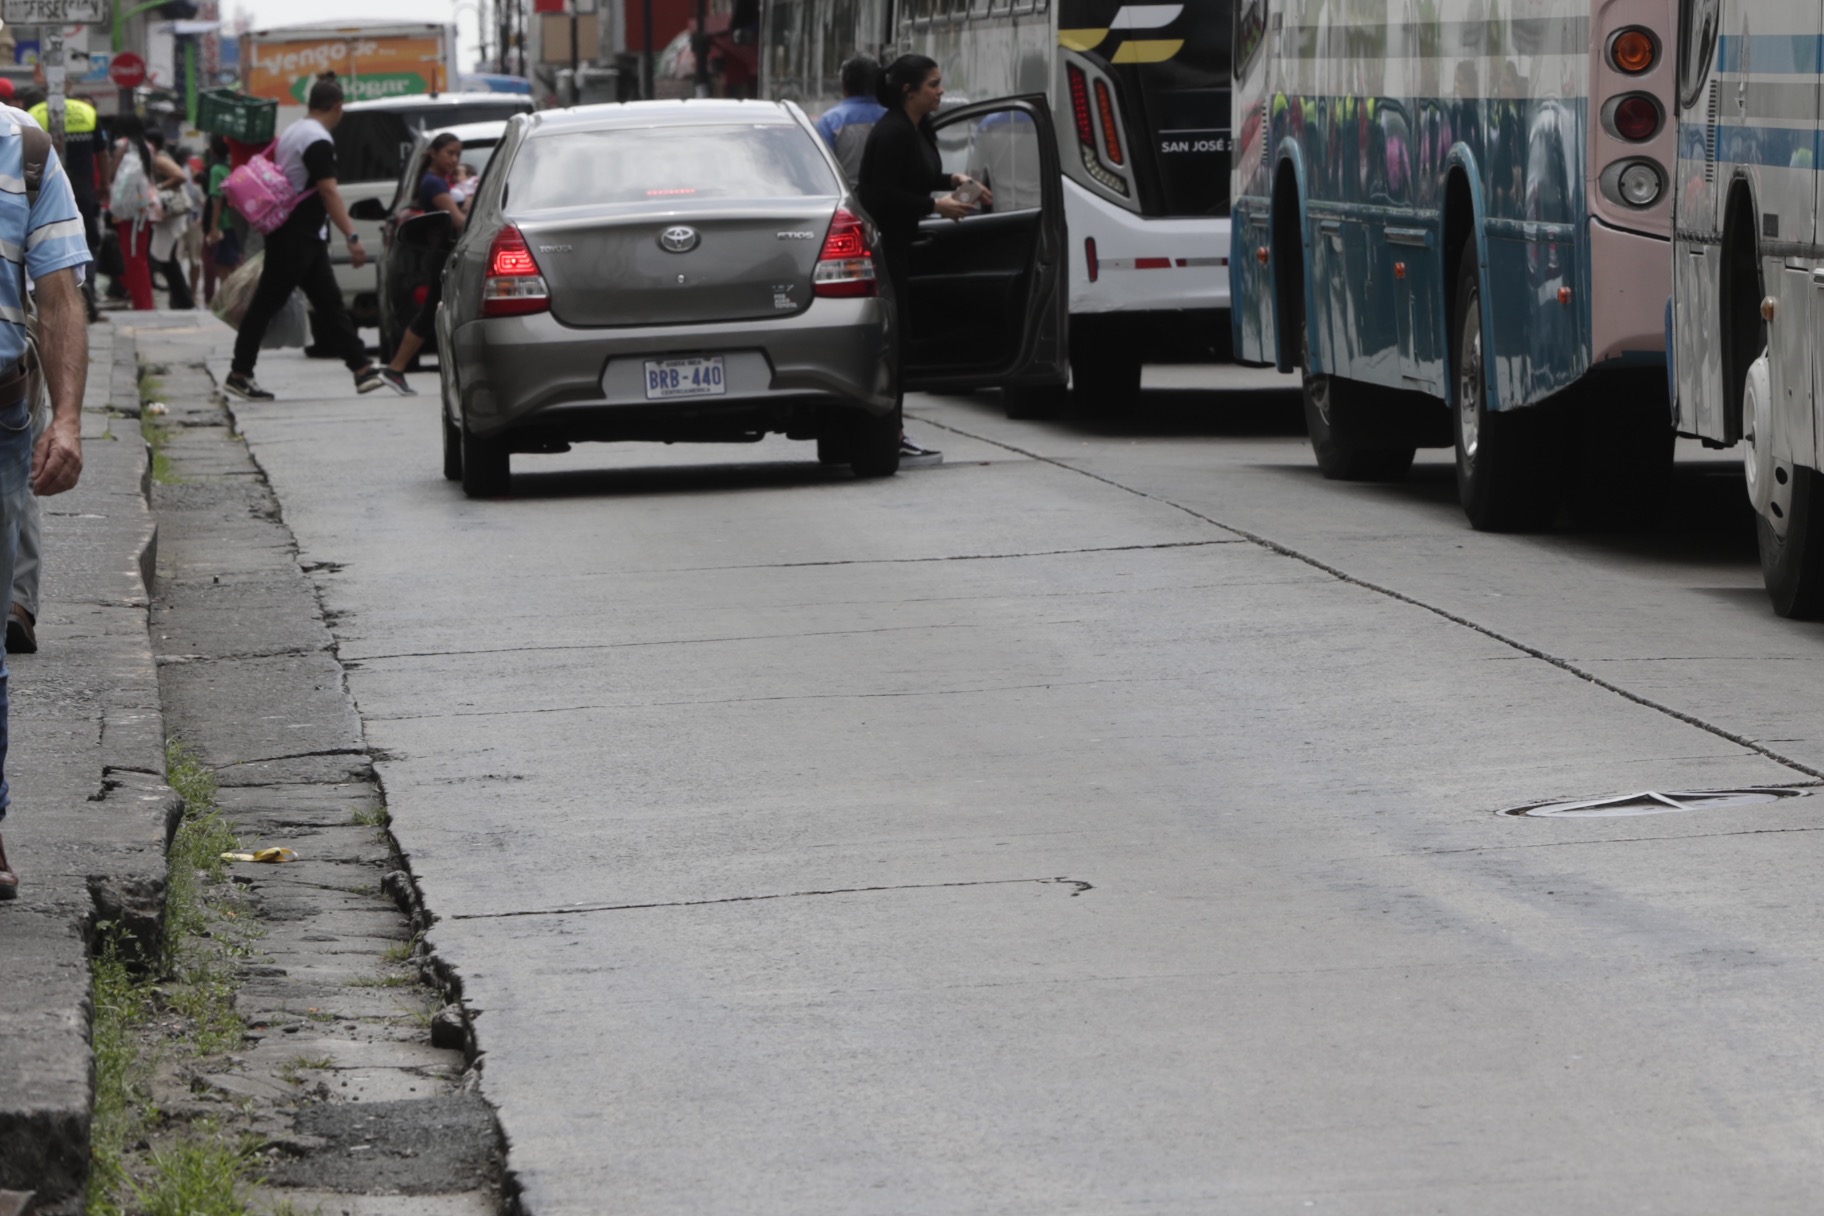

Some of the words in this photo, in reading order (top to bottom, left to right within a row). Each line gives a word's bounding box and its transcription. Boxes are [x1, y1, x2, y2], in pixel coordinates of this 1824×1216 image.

[1161, 141, 1189, 153] SAN
[1192, 138, 1224, 152] JOSÉ
[649, 366, 721, 390] BRB-440
